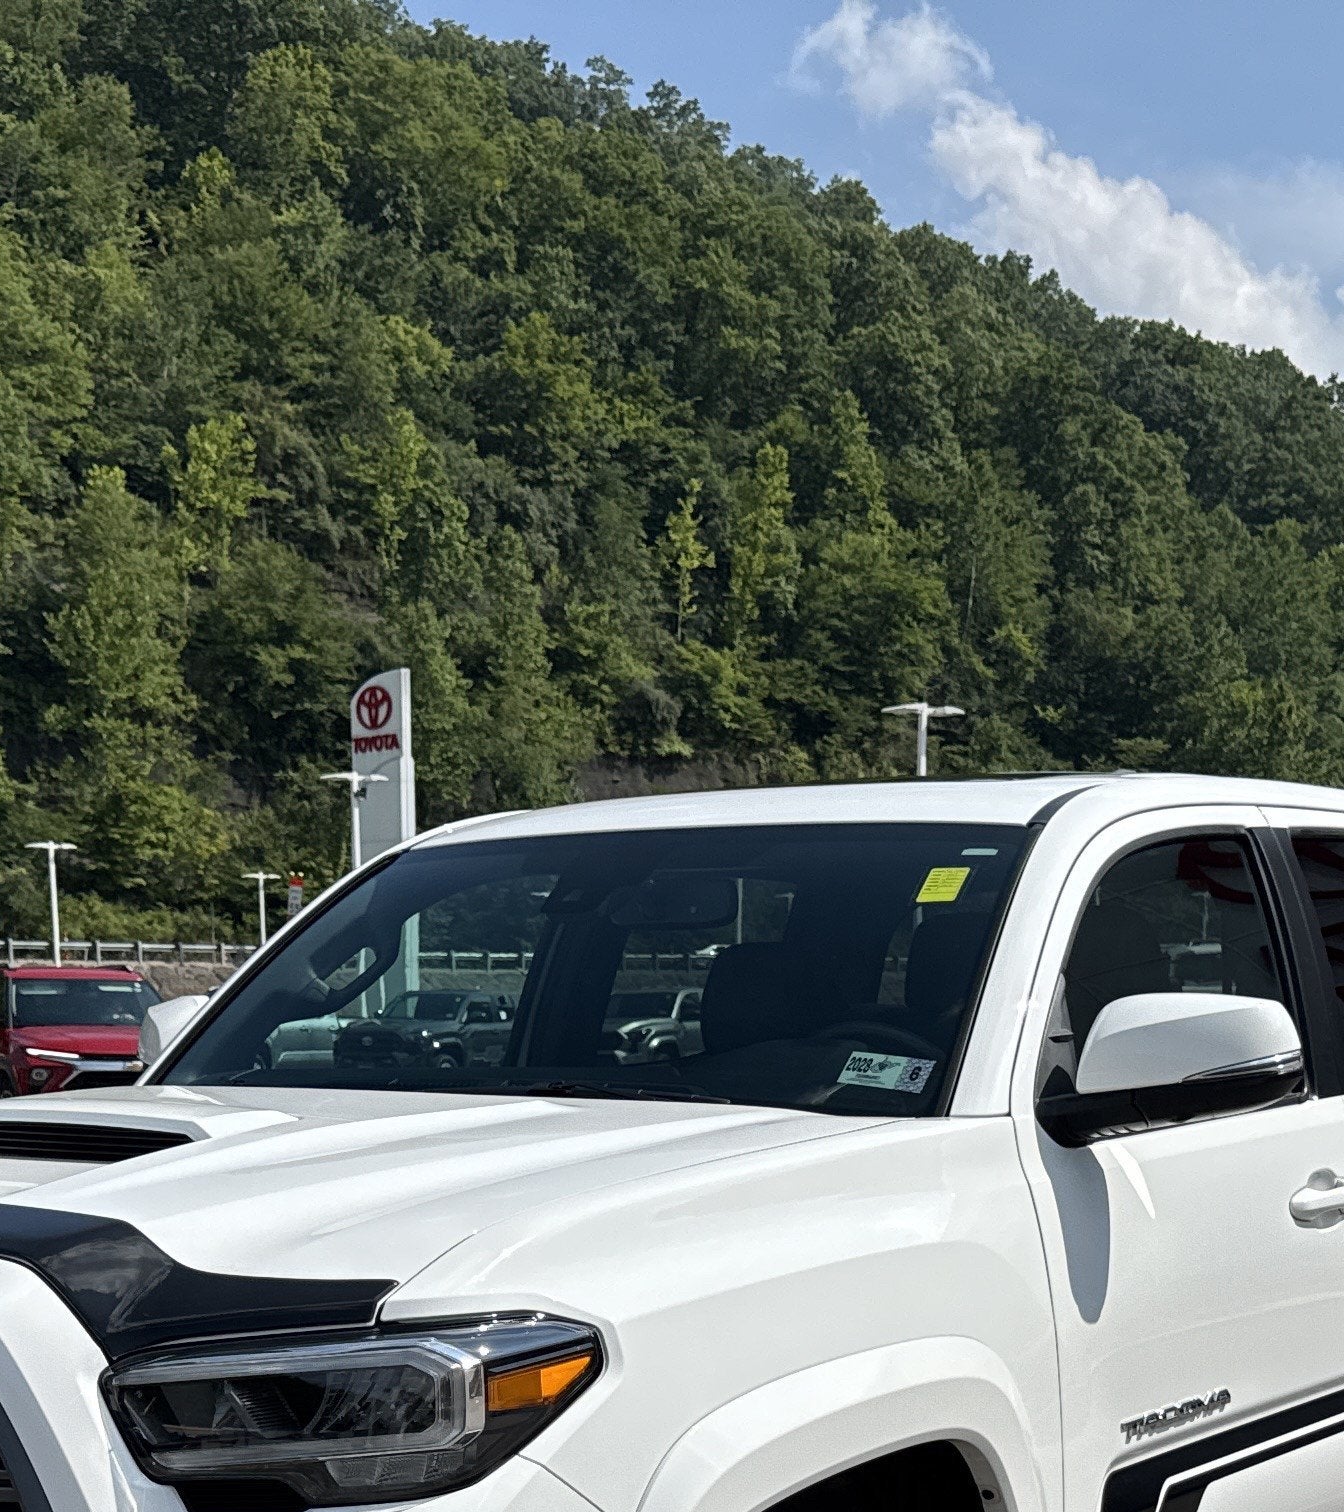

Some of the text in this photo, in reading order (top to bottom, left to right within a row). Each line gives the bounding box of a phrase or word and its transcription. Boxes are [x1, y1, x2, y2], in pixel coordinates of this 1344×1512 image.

[352, 733, 400, 754] TOYOTA
[909, 1065, 923, 1082] 6
[1120, 1387, 1232, 1444] TACOMA
